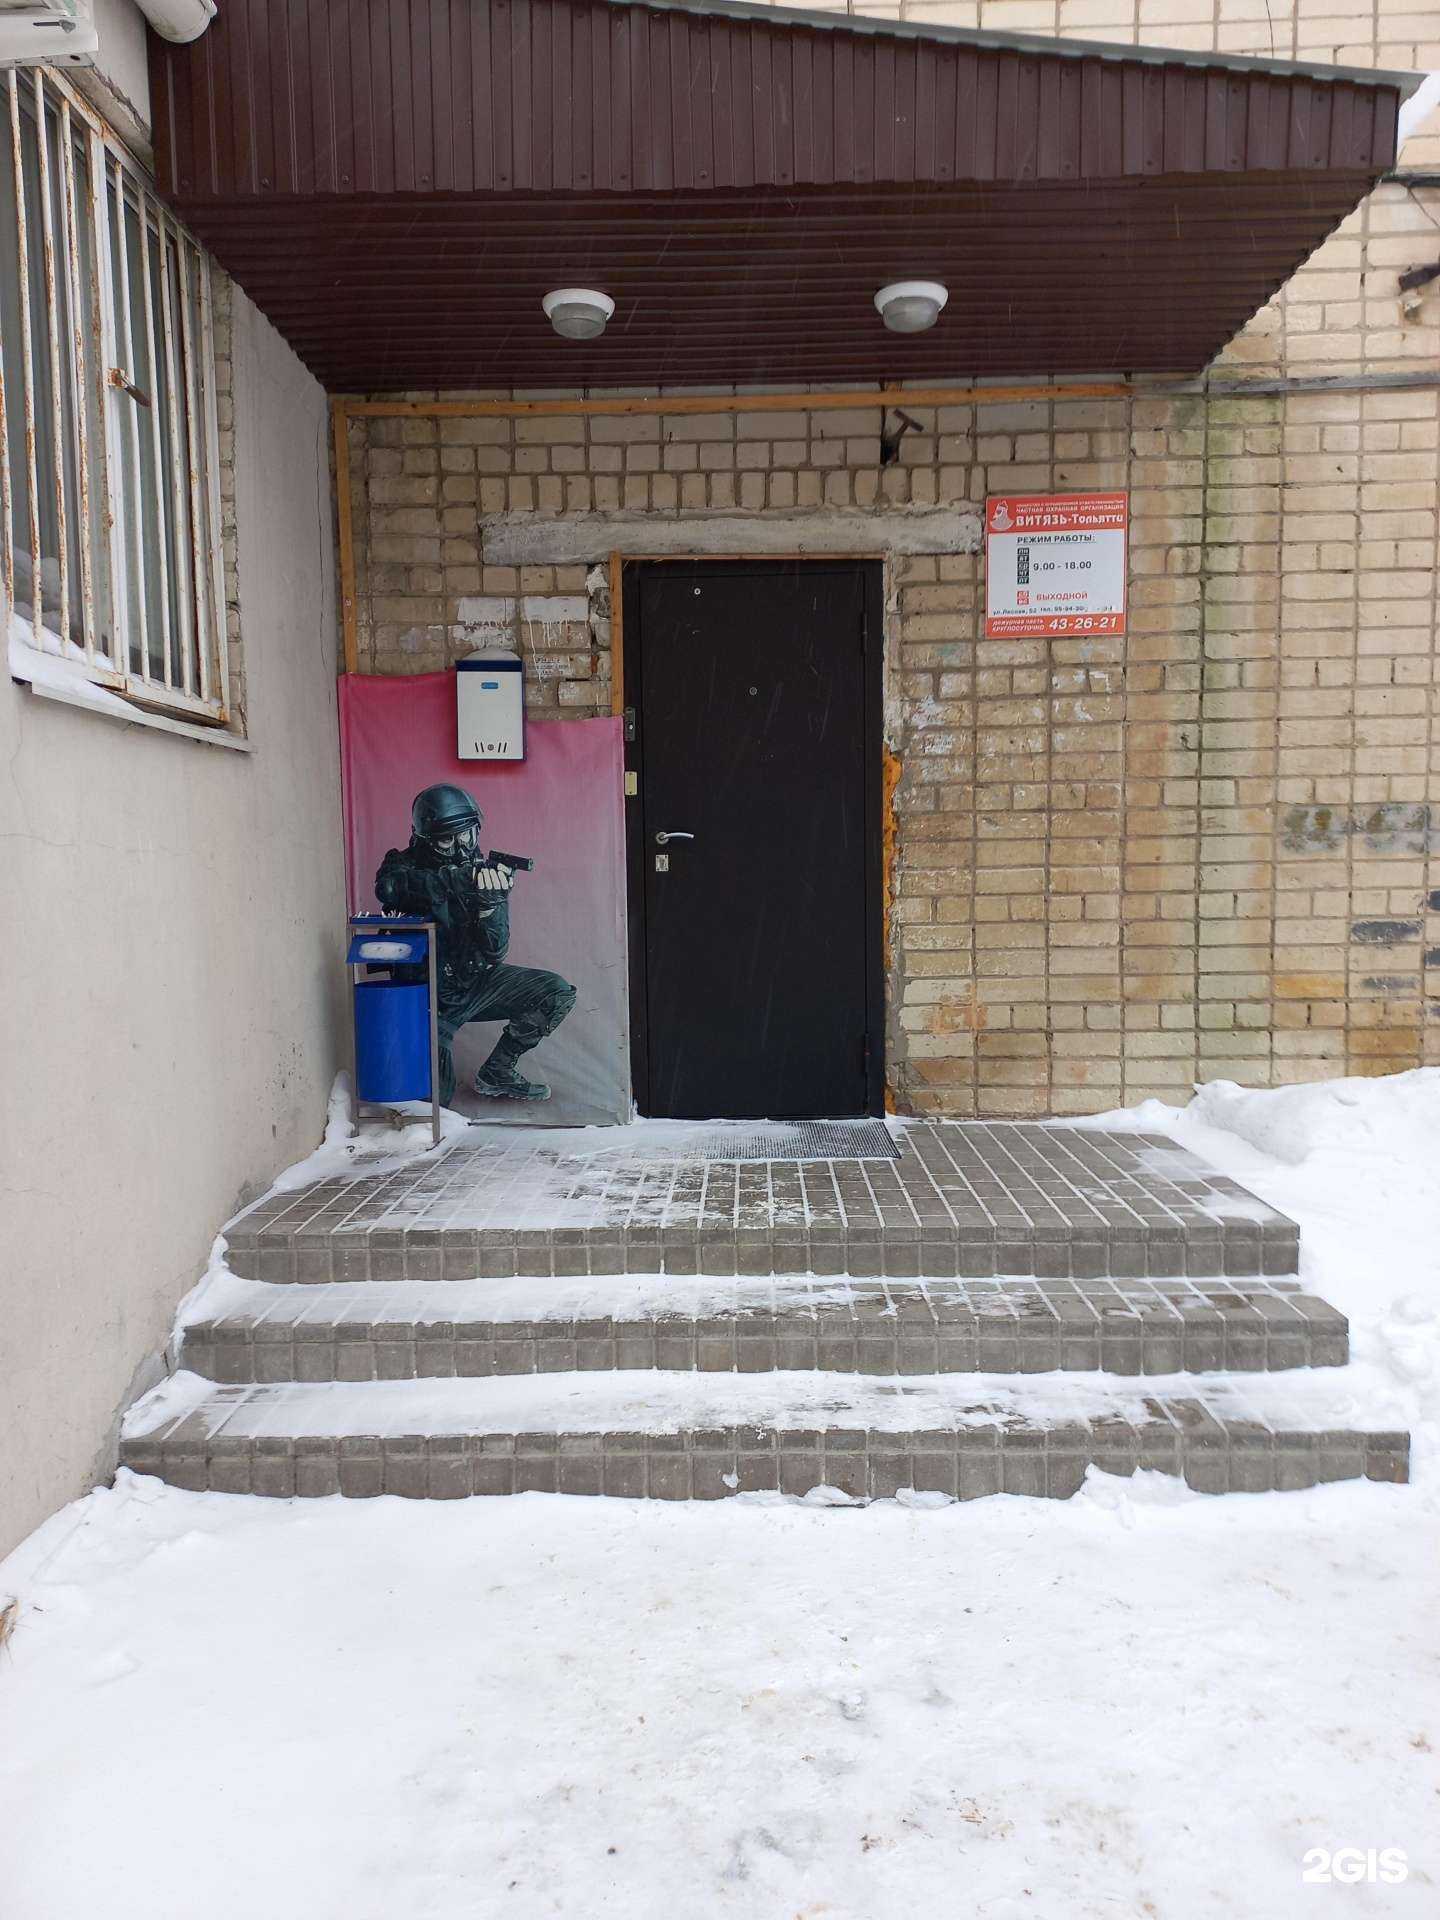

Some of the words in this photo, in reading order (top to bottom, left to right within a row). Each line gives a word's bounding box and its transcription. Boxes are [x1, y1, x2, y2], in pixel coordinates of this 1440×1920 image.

[1081, 503, 1124, 511] ОРГАНИЗАЦИЯ
[1017, 536, 1052, 544] РЕЖИМ
[1054, 534, 1096, 543] РАБОТЫ:
[1033, 562, 1055, 571] 9.00
[1064, 561, 1092, 570] 18.00
[1036, 592, 1088, 601] ВЫХОДНОЙ
[1048, 617, 1117, 631] 43-26-21
